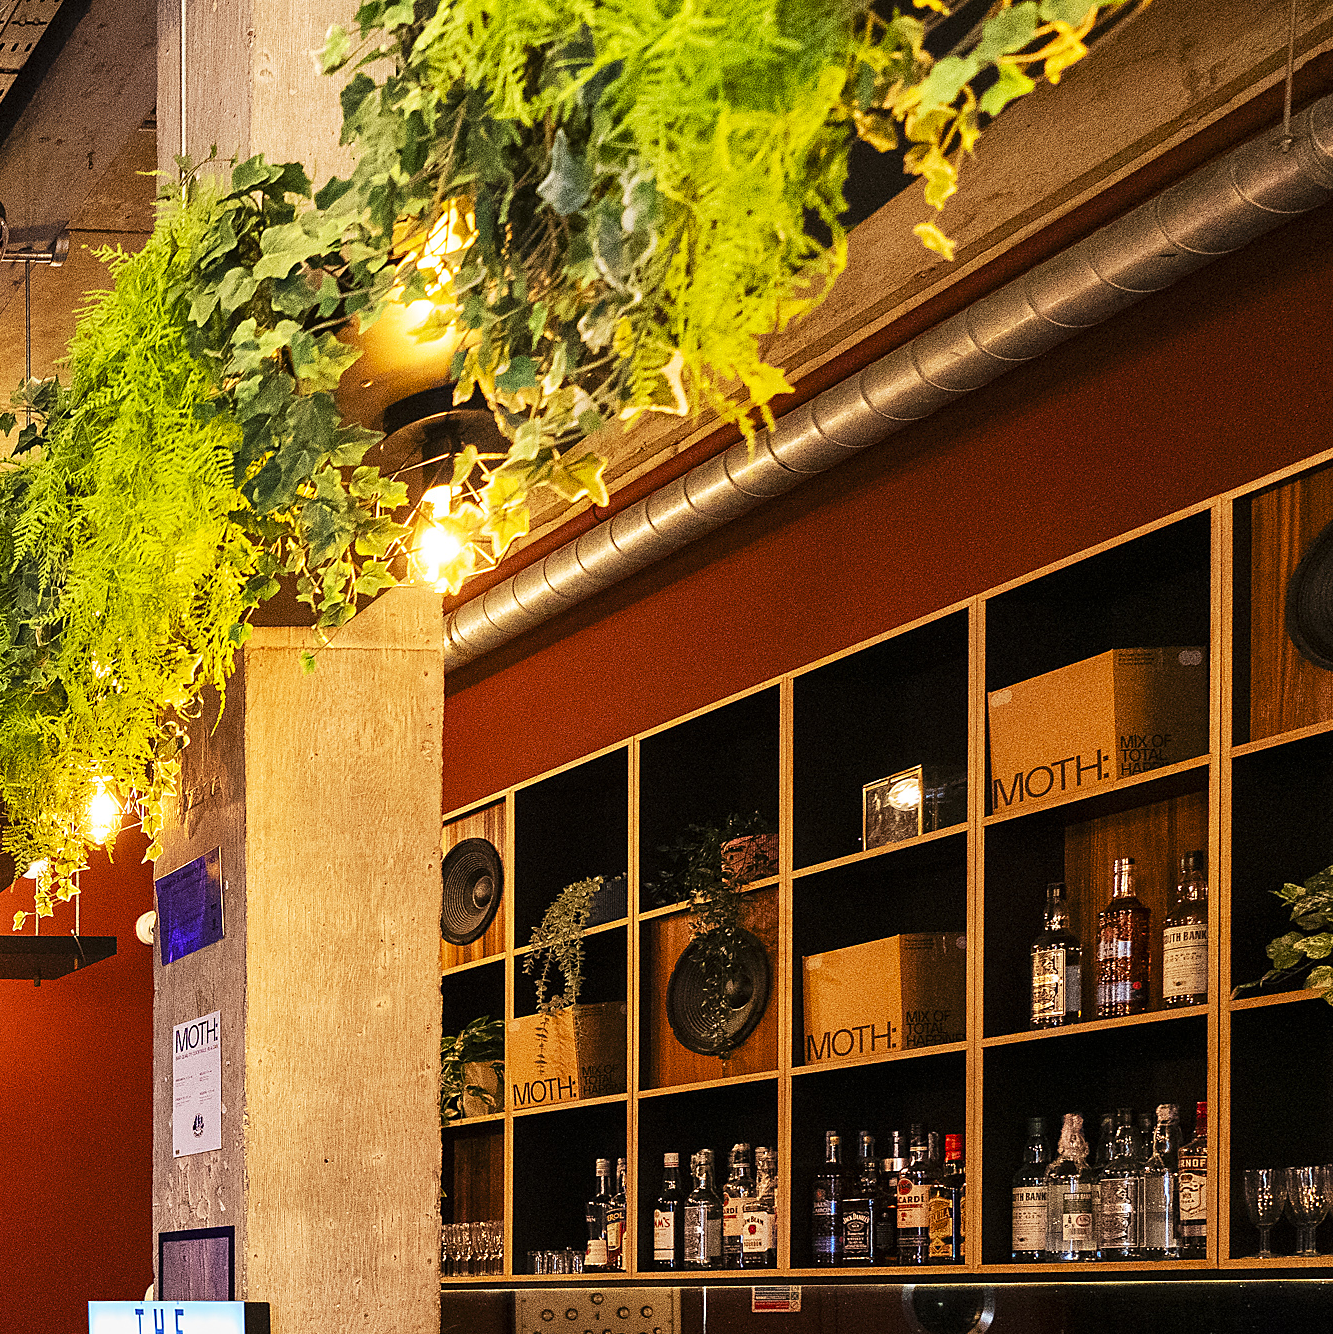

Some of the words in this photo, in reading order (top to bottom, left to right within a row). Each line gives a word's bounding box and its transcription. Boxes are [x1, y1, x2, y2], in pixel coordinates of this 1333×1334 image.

[1120, 734, 1148, 749] MIX
[1151, 734, 1172, 748] OF
[1120, 748, 1167, 763] TOTAL
[993, 749, 1109, 810] MOTH:
[1183, 930, 1207, 942] BANK
[906, 1010, 930, 1023] MIX
[933, 1009, 952, 1022] OF
[175, 1017, 219, 1054] MOTH:
[906, 1022, 948, 1035] TOTAL
[807, 1021, 897, 1062] MOTH:
[513, 1075, 577, 1107] MOTH:
[1025, 1191, 1047, 1201] BANK
